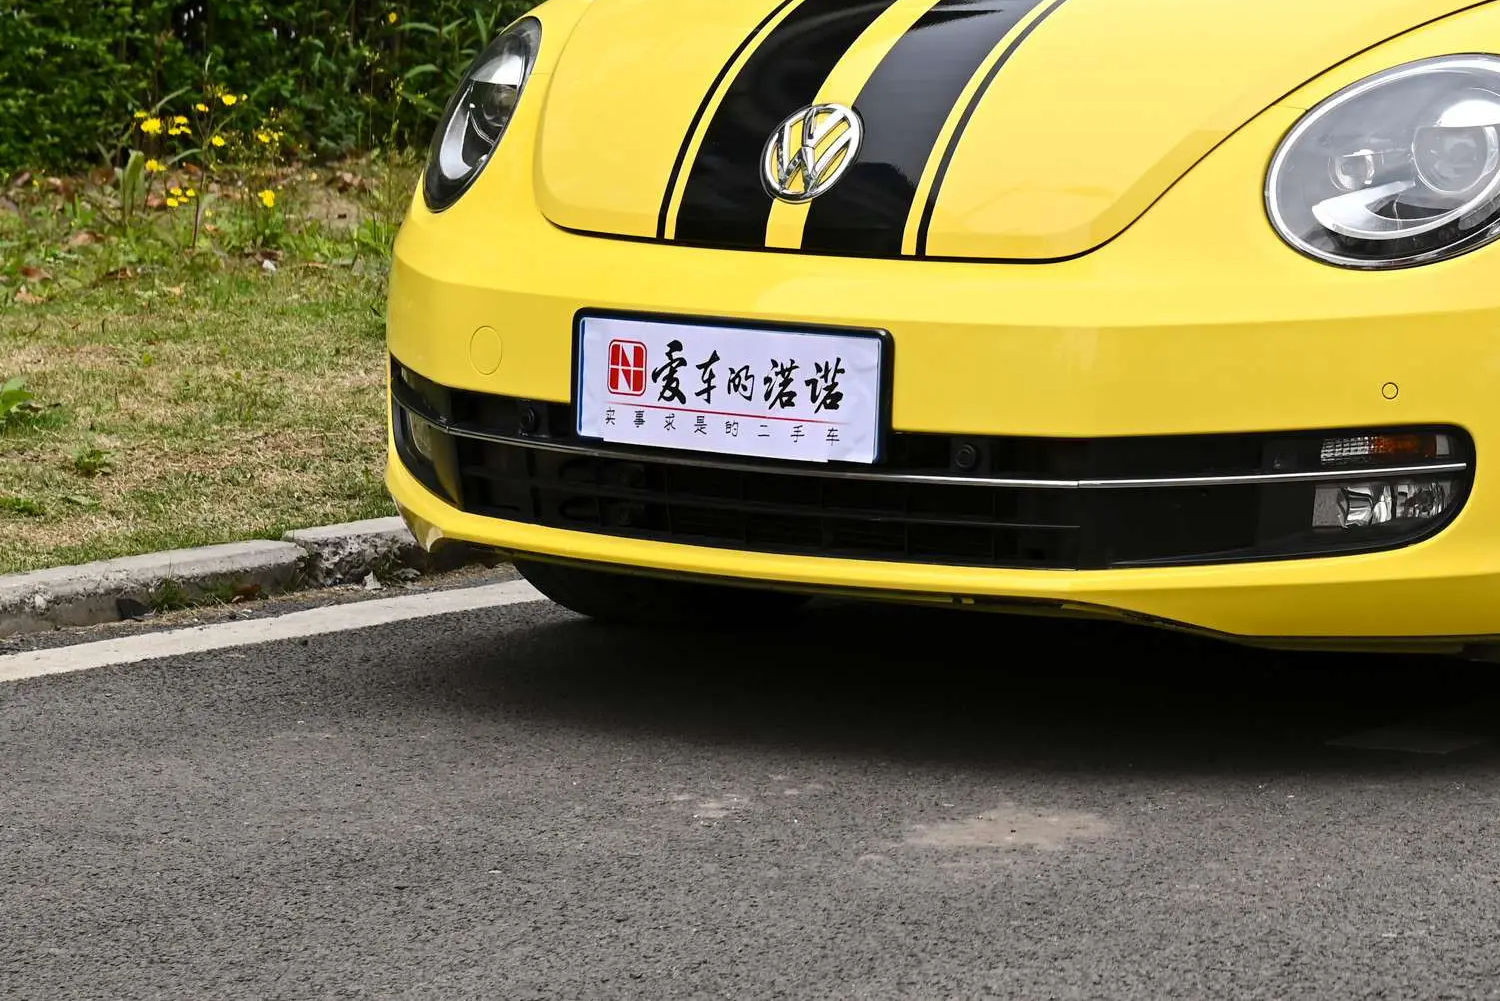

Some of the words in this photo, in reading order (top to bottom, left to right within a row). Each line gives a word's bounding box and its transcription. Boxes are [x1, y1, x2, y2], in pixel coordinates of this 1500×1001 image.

[762, 103, 863, 202] VW
[605, 407, 840, 446] 实事求是的二手车
